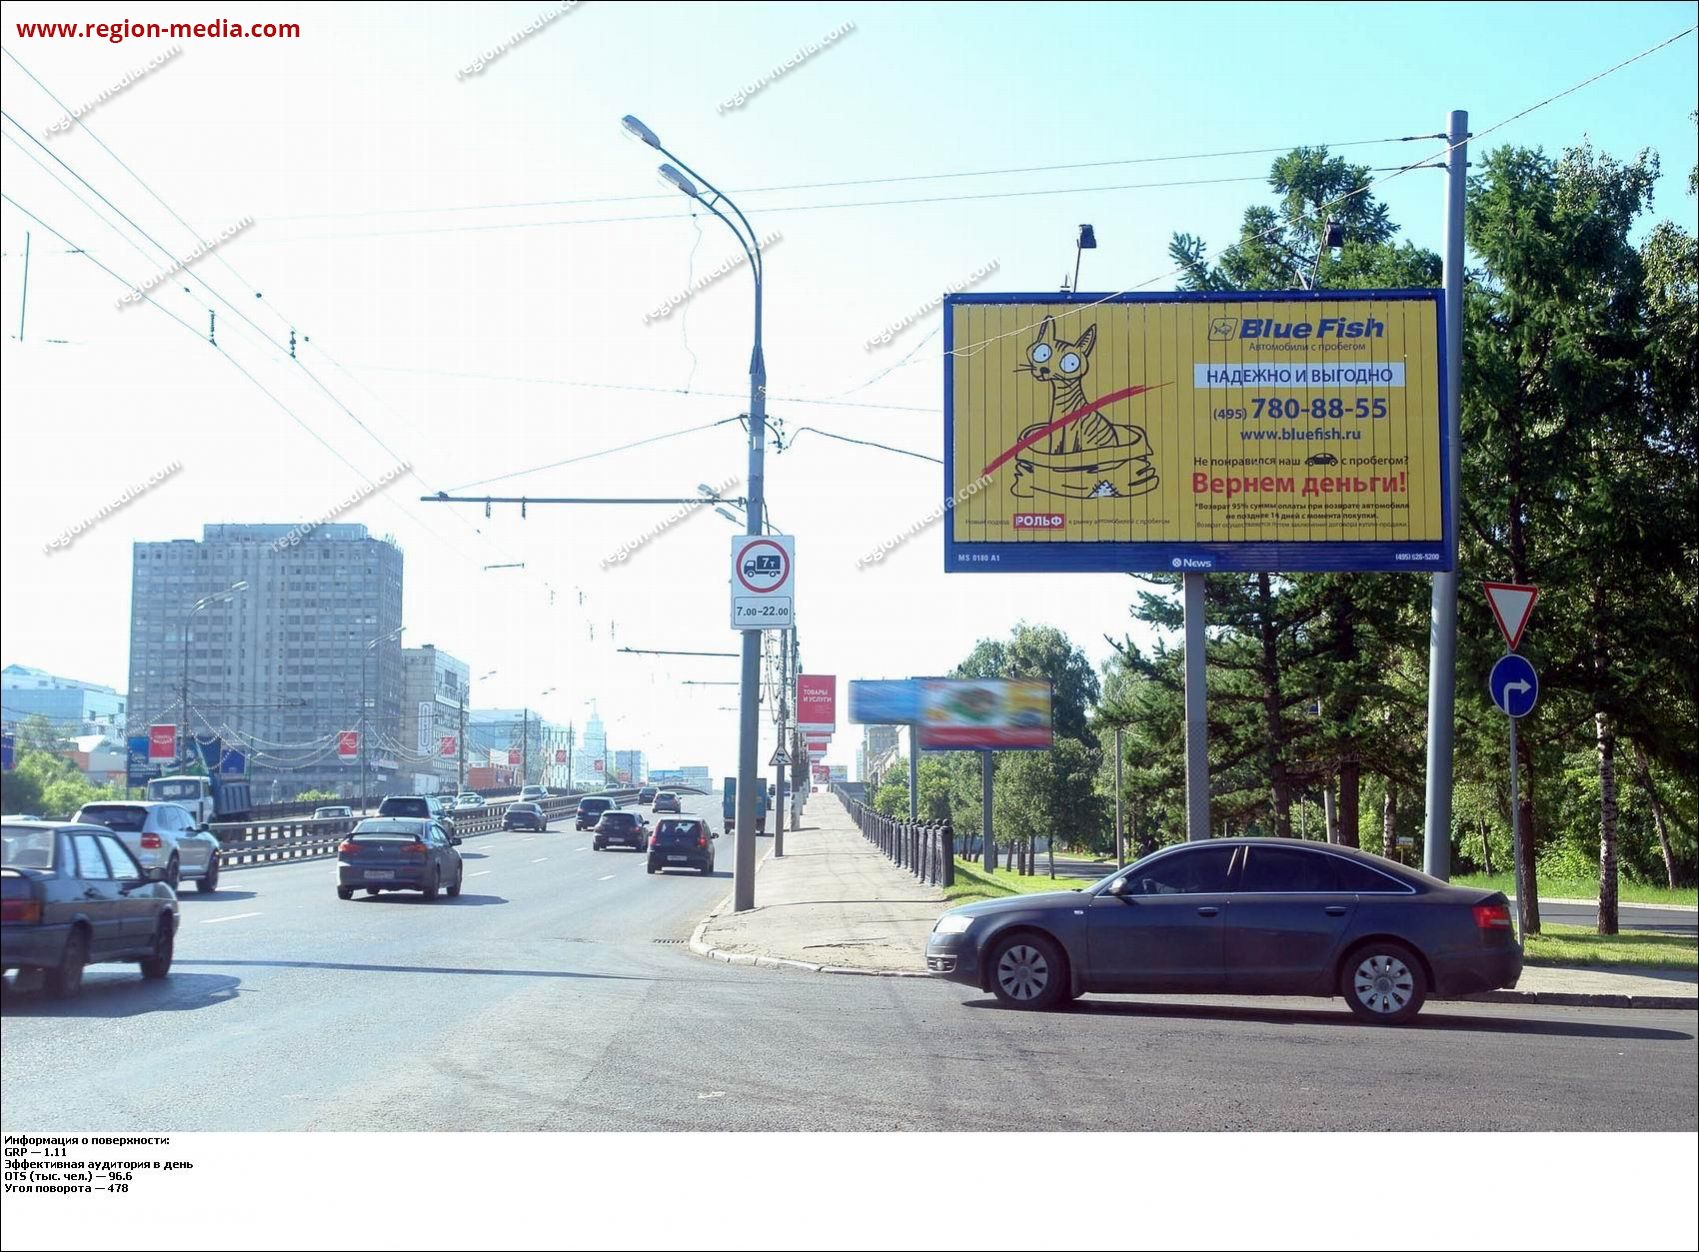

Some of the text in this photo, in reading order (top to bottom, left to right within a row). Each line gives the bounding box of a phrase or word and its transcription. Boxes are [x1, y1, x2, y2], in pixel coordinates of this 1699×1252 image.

[1239, 317, 1384, 339] Blue Fish
[1249, 341, 1308, 352] Автомобили
[1318, 341, 1366, 353] пробегом
[1207, 368, 1393, 385] НАДЕЖНО И ВЫГОДНО
[1213, 397, 1388, 421] (495) 780-88-55
[1240, 427, 1361, 441] www.bluefish.ru
[1194, 457, 1208, 466] Не
[1211, 457, 1277, 468] понравился
[1279, 458, 1300, 466] наш
[1349, 456, 1409, 468] пробегом?
[1192, 472, 1296, 499] Вернем
[1015, 515, 1063, 527] РОЛЬФ
[1183, 558, 1212, 568] News
[736, 606, 789, 617] 7.00-22.00
